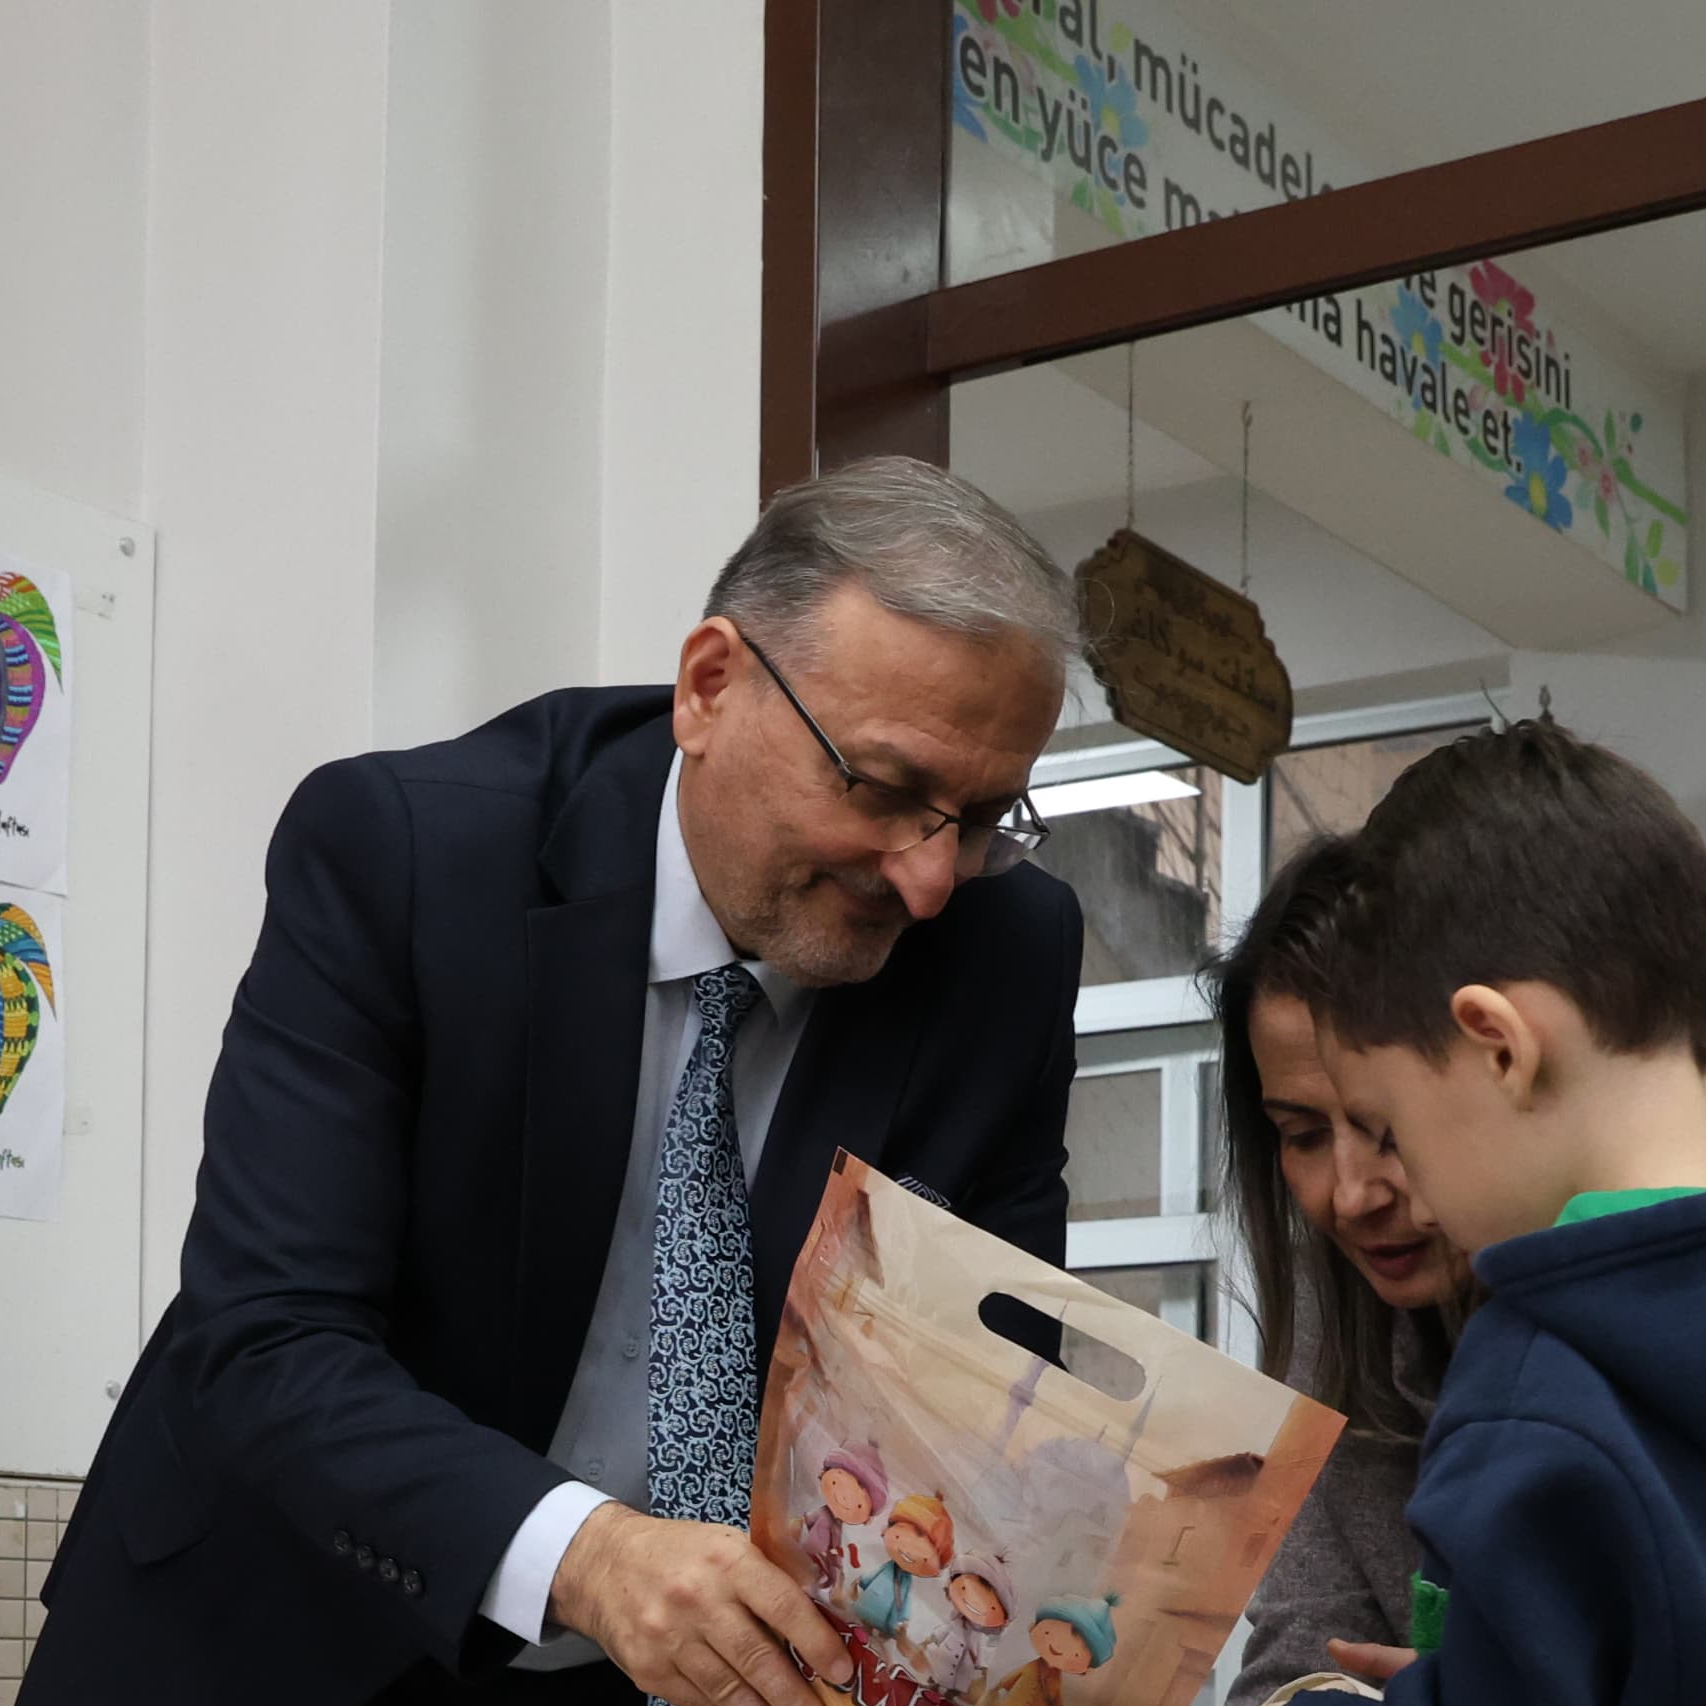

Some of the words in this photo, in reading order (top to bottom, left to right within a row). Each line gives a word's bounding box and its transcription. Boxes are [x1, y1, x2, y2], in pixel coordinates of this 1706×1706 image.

[960, 35, 1021, 125] en
[1036, 86, 1148, 210] yüce
[1356, 298, 1471, 436] havale
[1482, 408, 1522, 474] et.
[1448, 282, 1571, 411] gerisini
